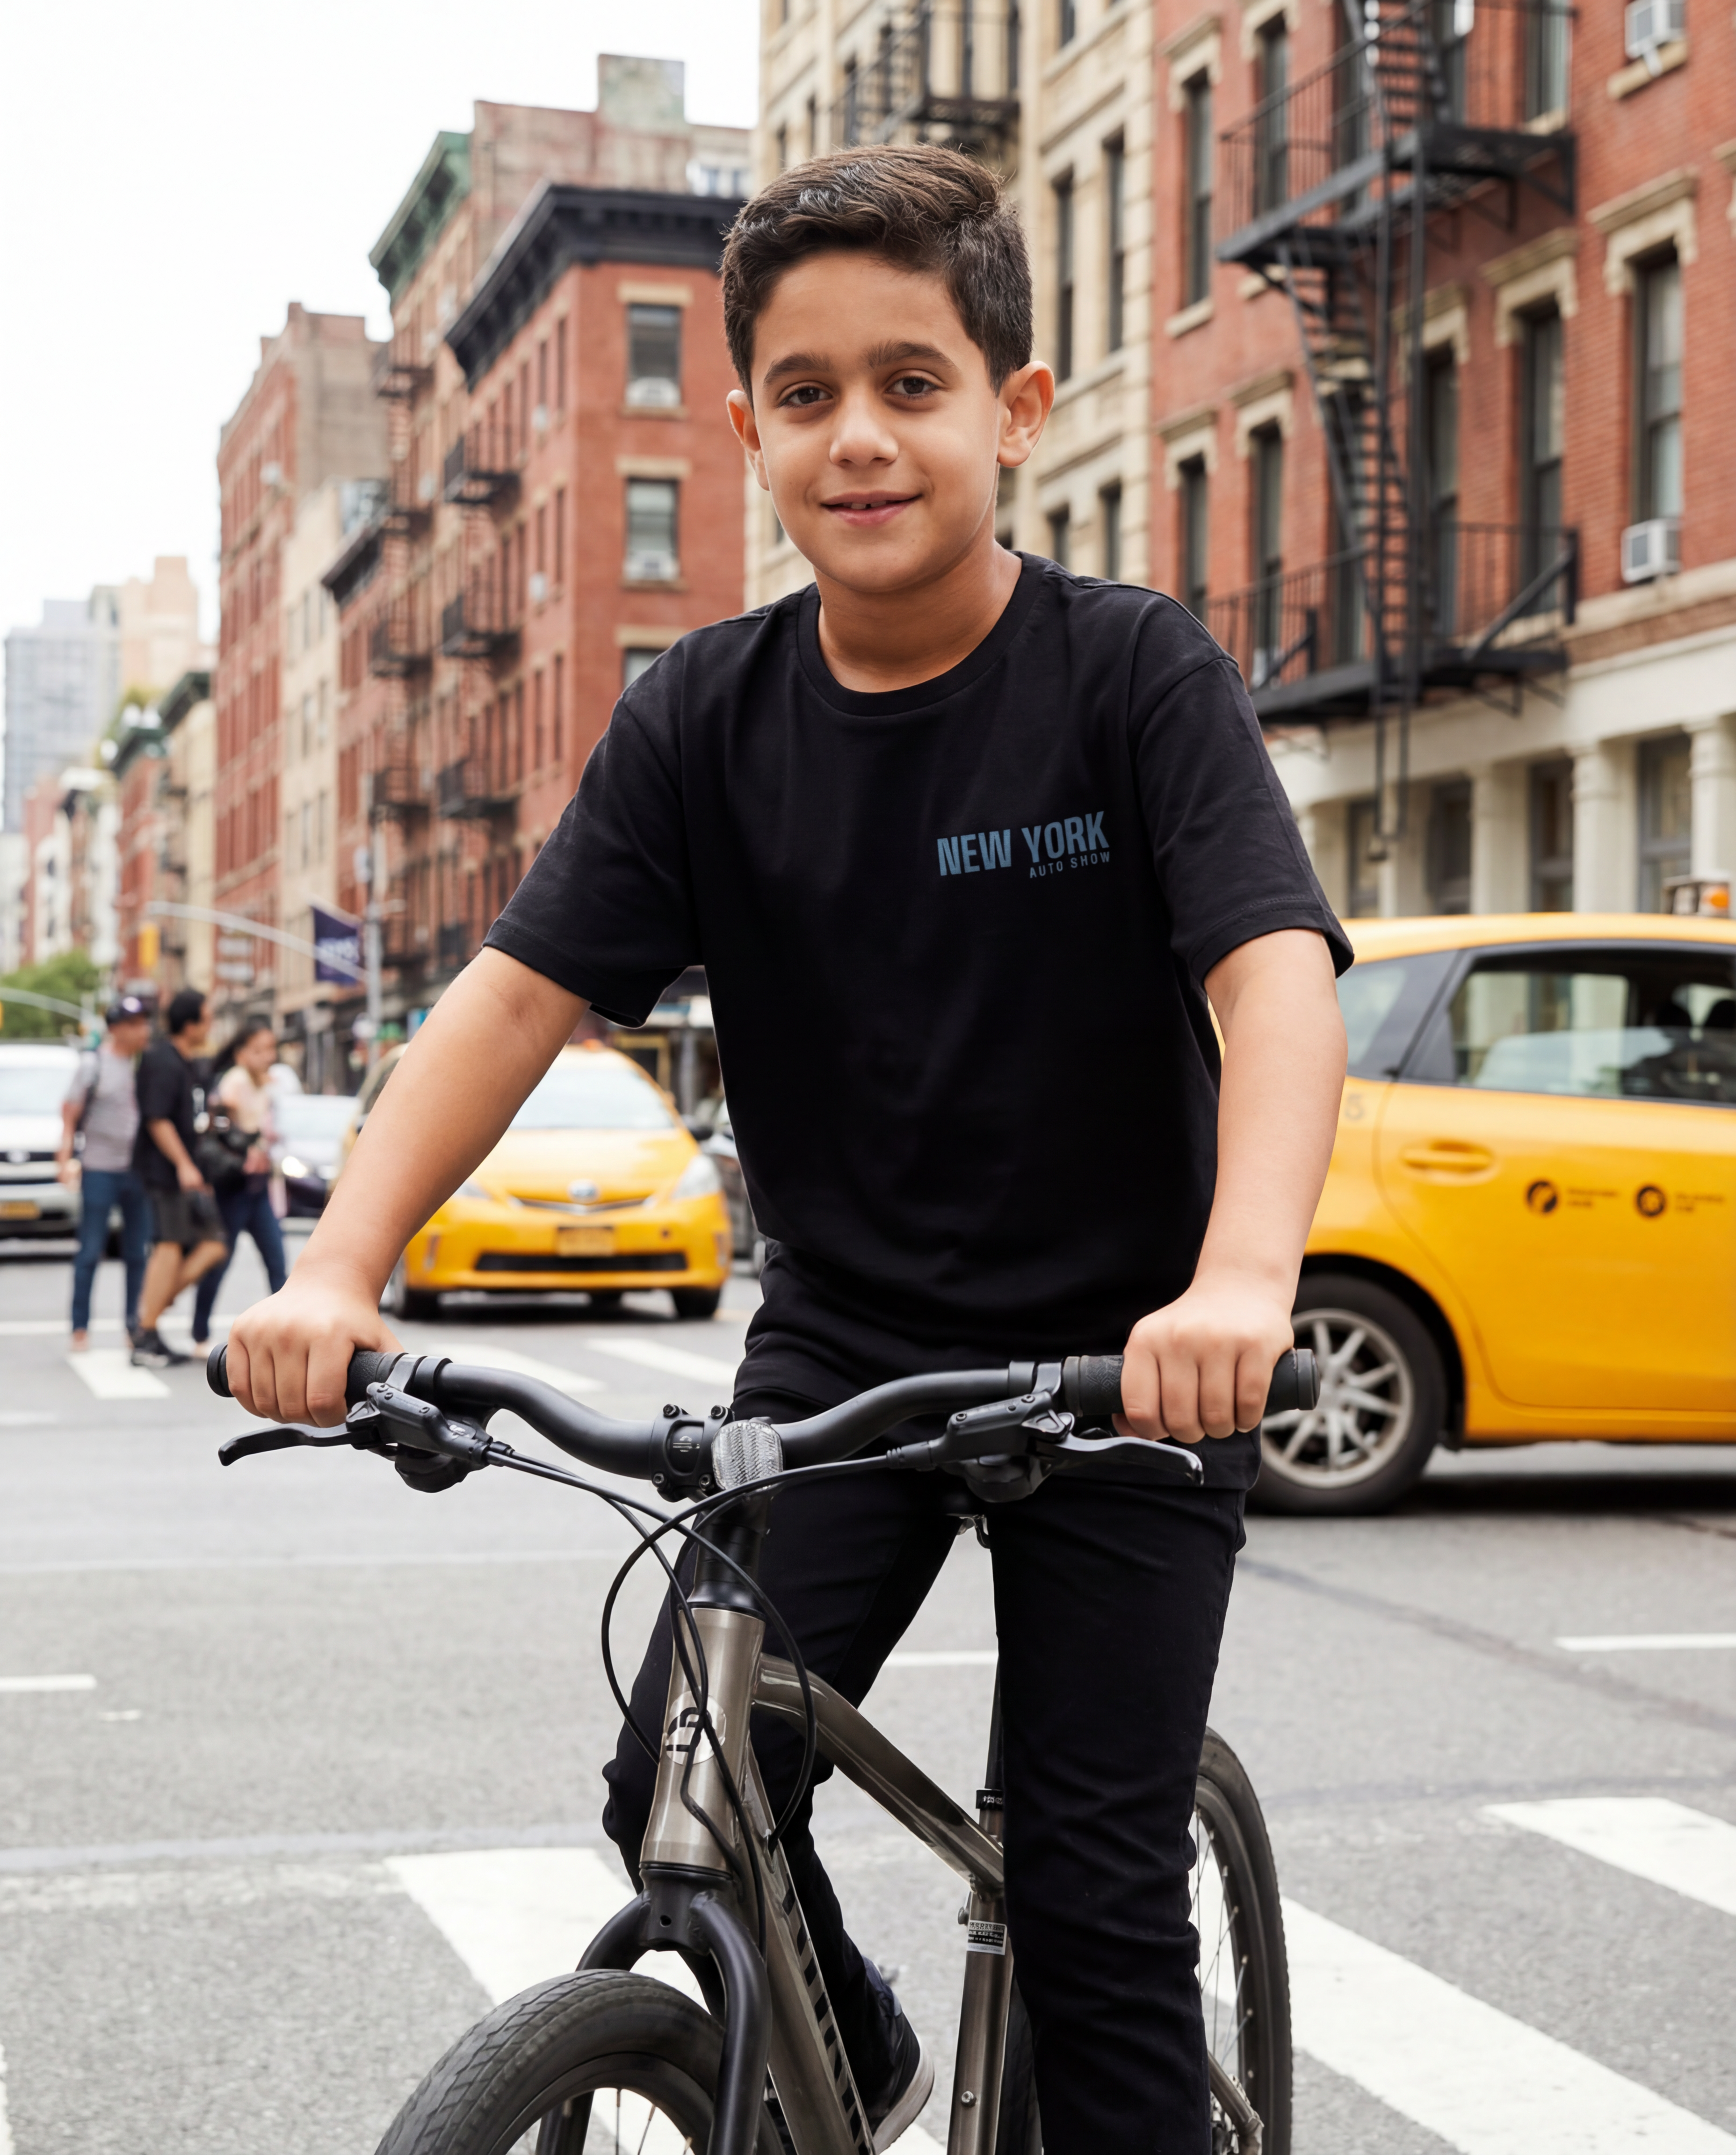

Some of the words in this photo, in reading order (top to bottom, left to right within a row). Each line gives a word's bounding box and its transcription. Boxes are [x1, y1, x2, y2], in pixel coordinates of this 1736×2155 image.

[937, 829, 1012, 876] NEW
[1021, 811, 1110, 863] YORK
[1029, 861, 1063, 878] AUTO
[1071, 851, 1110, 868] SHOW
